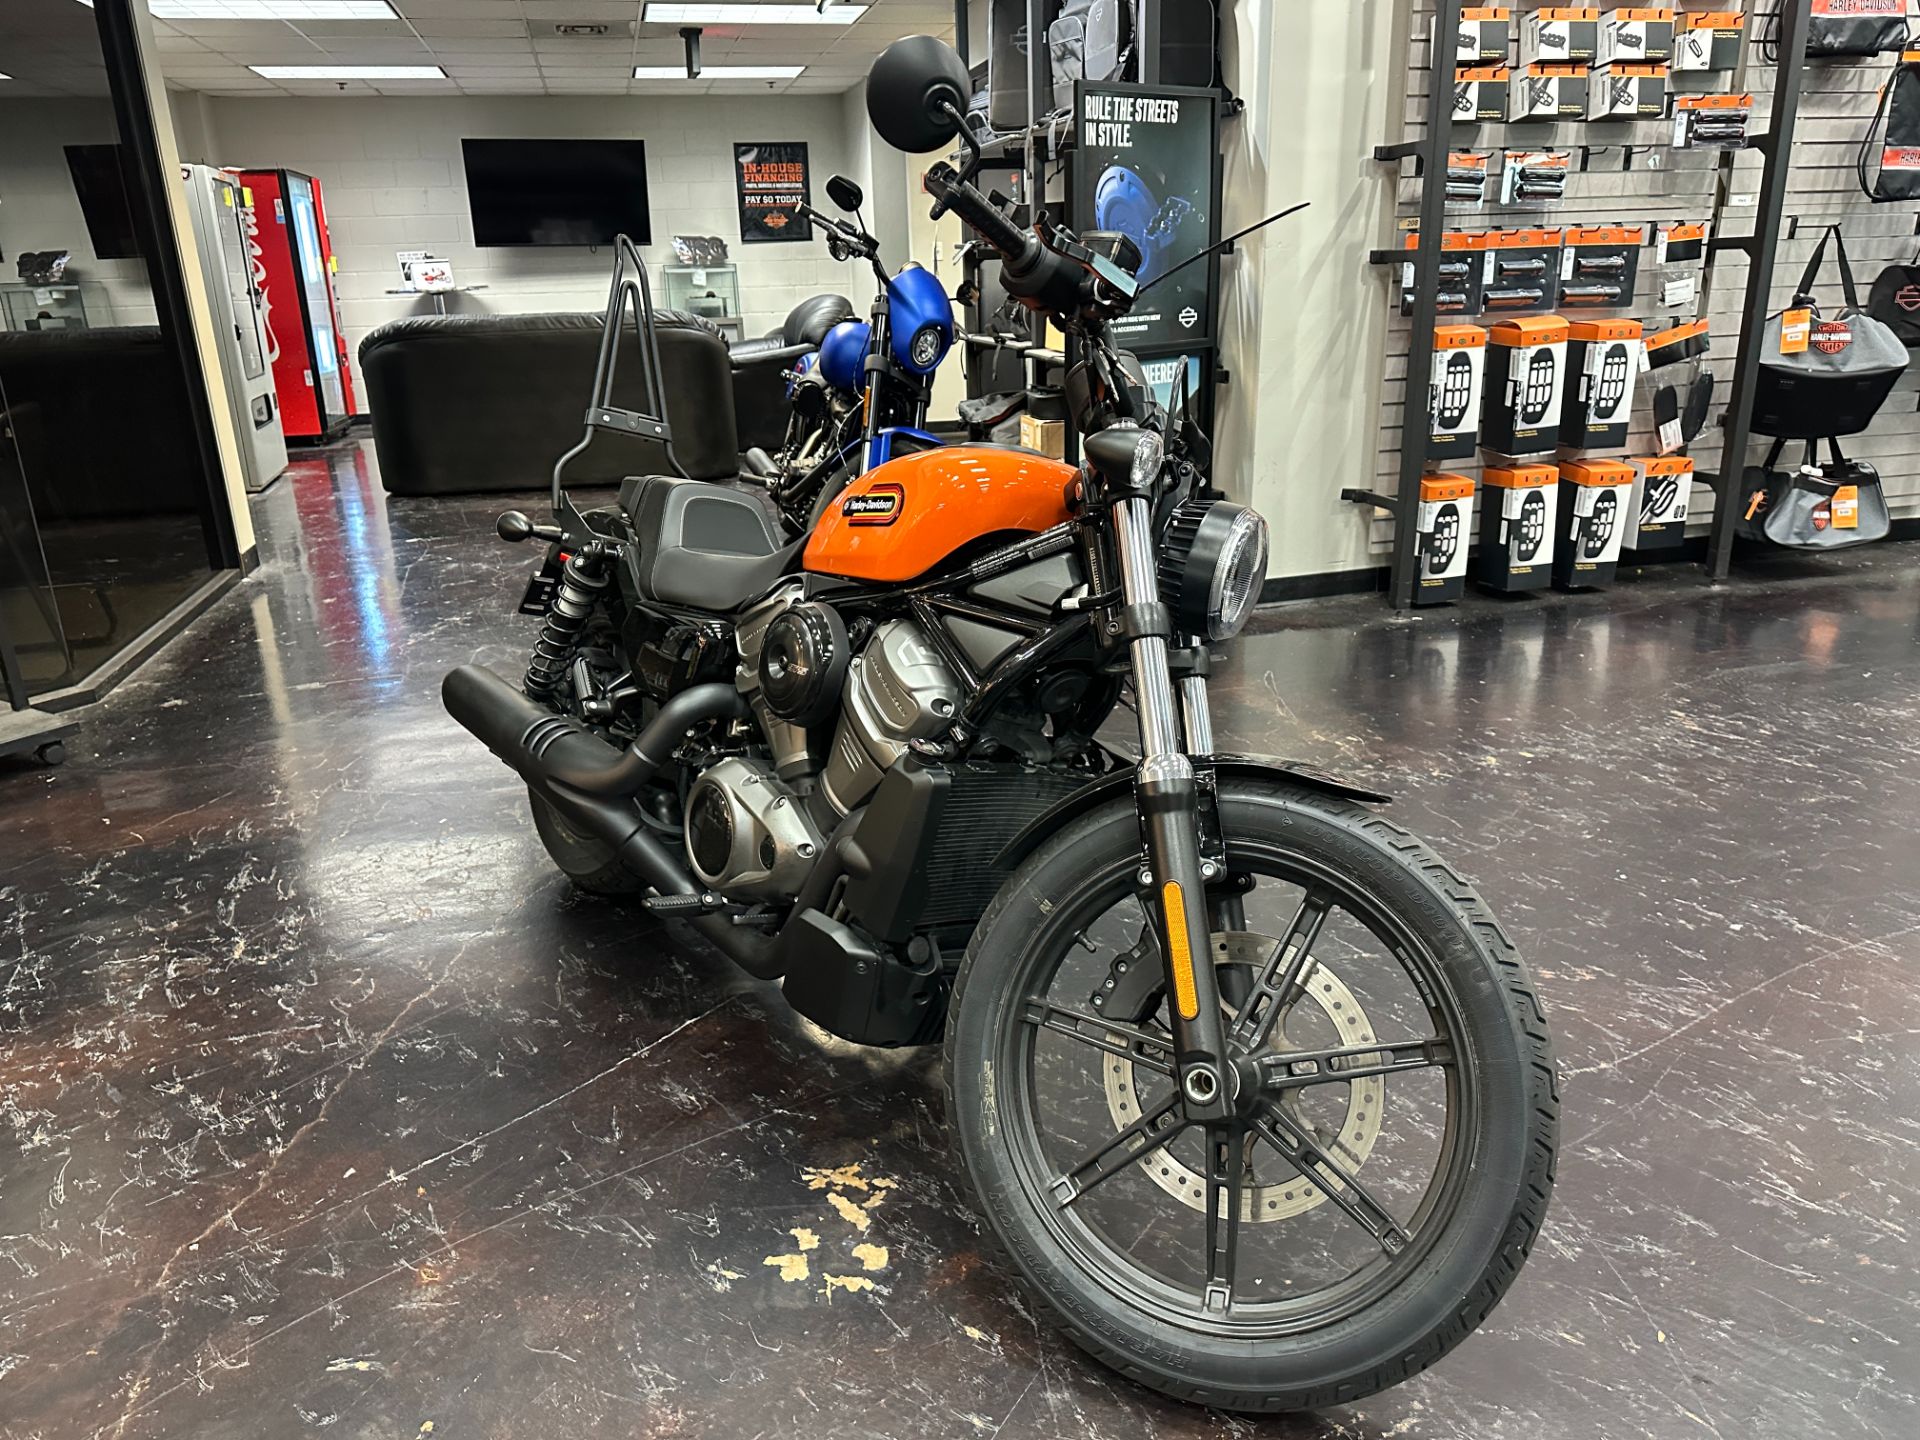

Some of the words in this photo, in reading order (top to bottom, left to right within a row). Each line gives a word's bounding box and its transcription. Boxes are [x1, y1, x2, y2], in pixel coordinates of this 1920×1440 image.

[1829, 0, 1857, 11] HARLEY
[1861, 0, 1897, 11] DAVIDSON
[1085, 95, 1112, 120] RULE
[1113, 97, 1135, 122] THE
[1135, 98, 1179, 124] STREETS
[1085, 123, 1097, 146] IN
[1098, 124, 1133, 147] STYLE.
[743, 163, 803, 173] IN-HOUSE
[744, 173, 803, 183] FINANCING
[745, 196, 761, 204] PAY
[763, 195, 774, 204] $0
[775, 195, 802, 203] TODAY
[850, 499, 893, 511] Harley-Davidson
[1305, 823, 1404, 882] DUNLOP
[988, 1191, 1192, 1370] HARLEY-DAVIDSON
